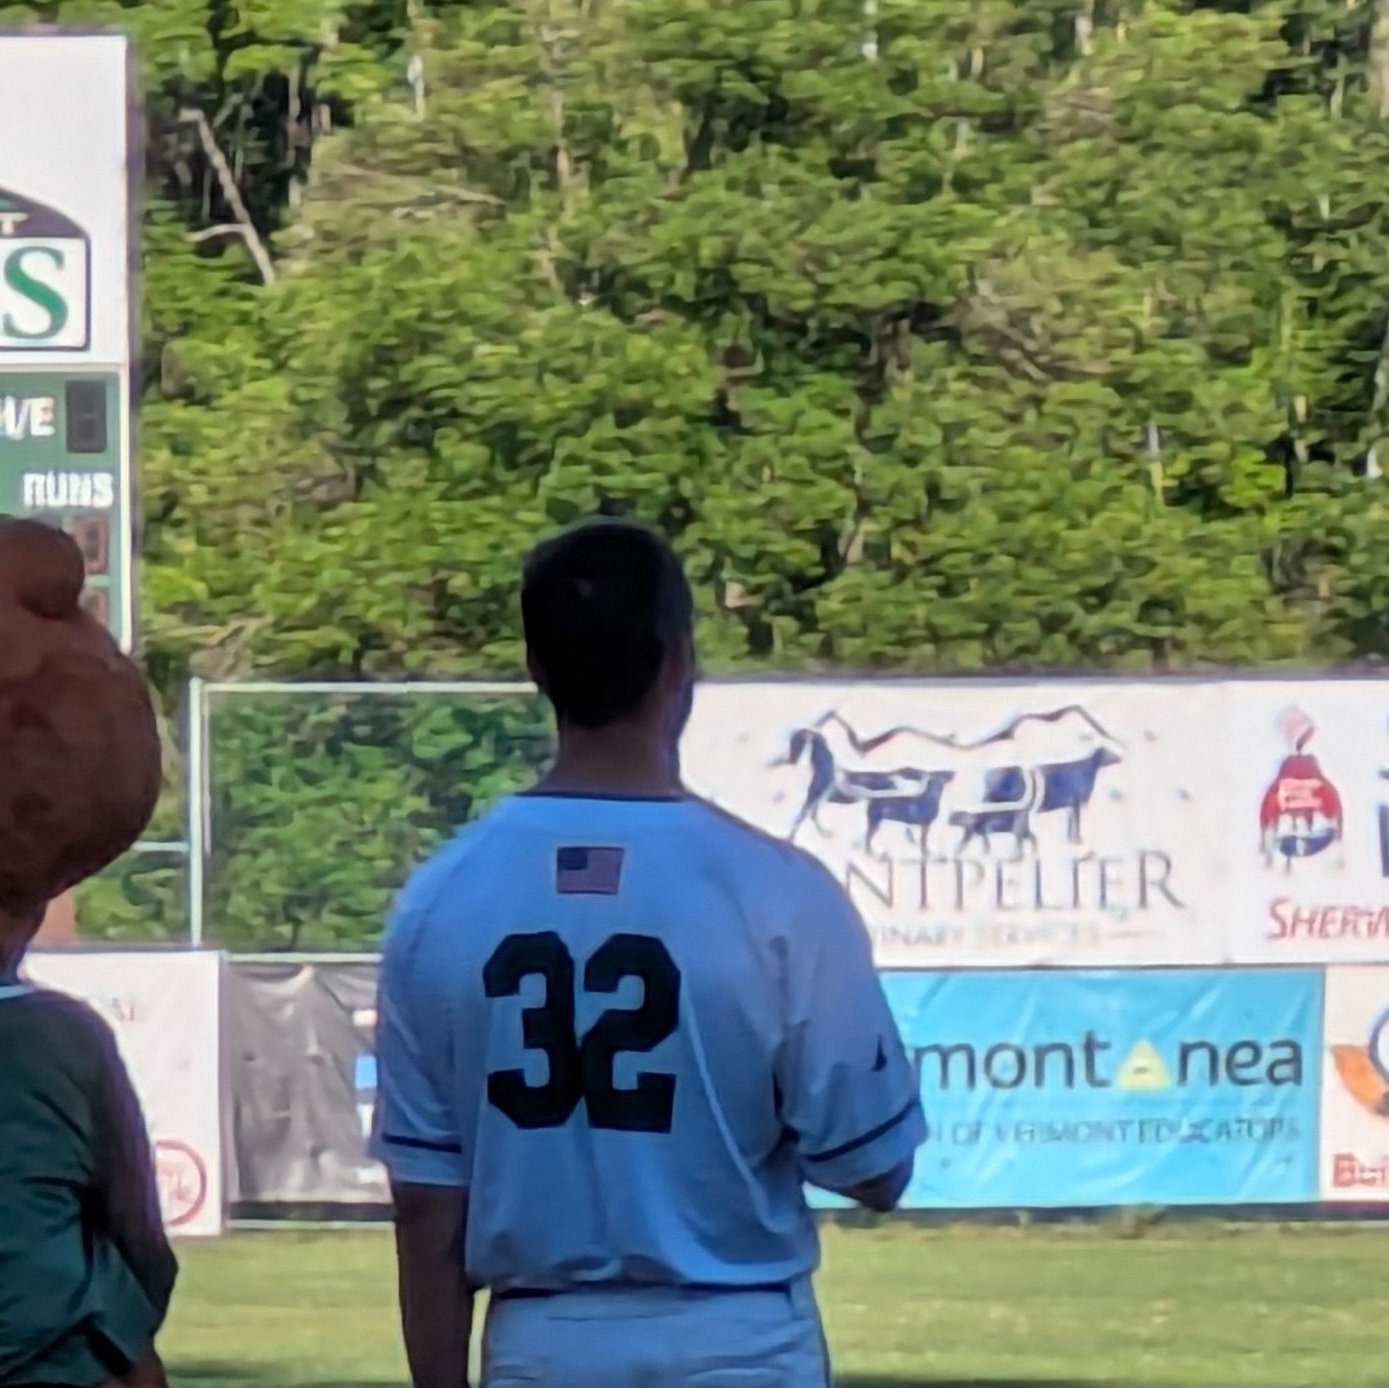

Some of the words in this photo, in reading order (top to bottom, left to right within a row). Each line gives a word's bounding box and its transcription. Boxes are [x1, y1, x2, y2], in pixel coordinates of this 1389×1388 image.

[845, 850, 1186, 909] NTPELIER
[482, 930, 682, 1134] 32
[914, 1030, 1112, 1090] mont
[1178, 1037, 1303, 1088] nea
